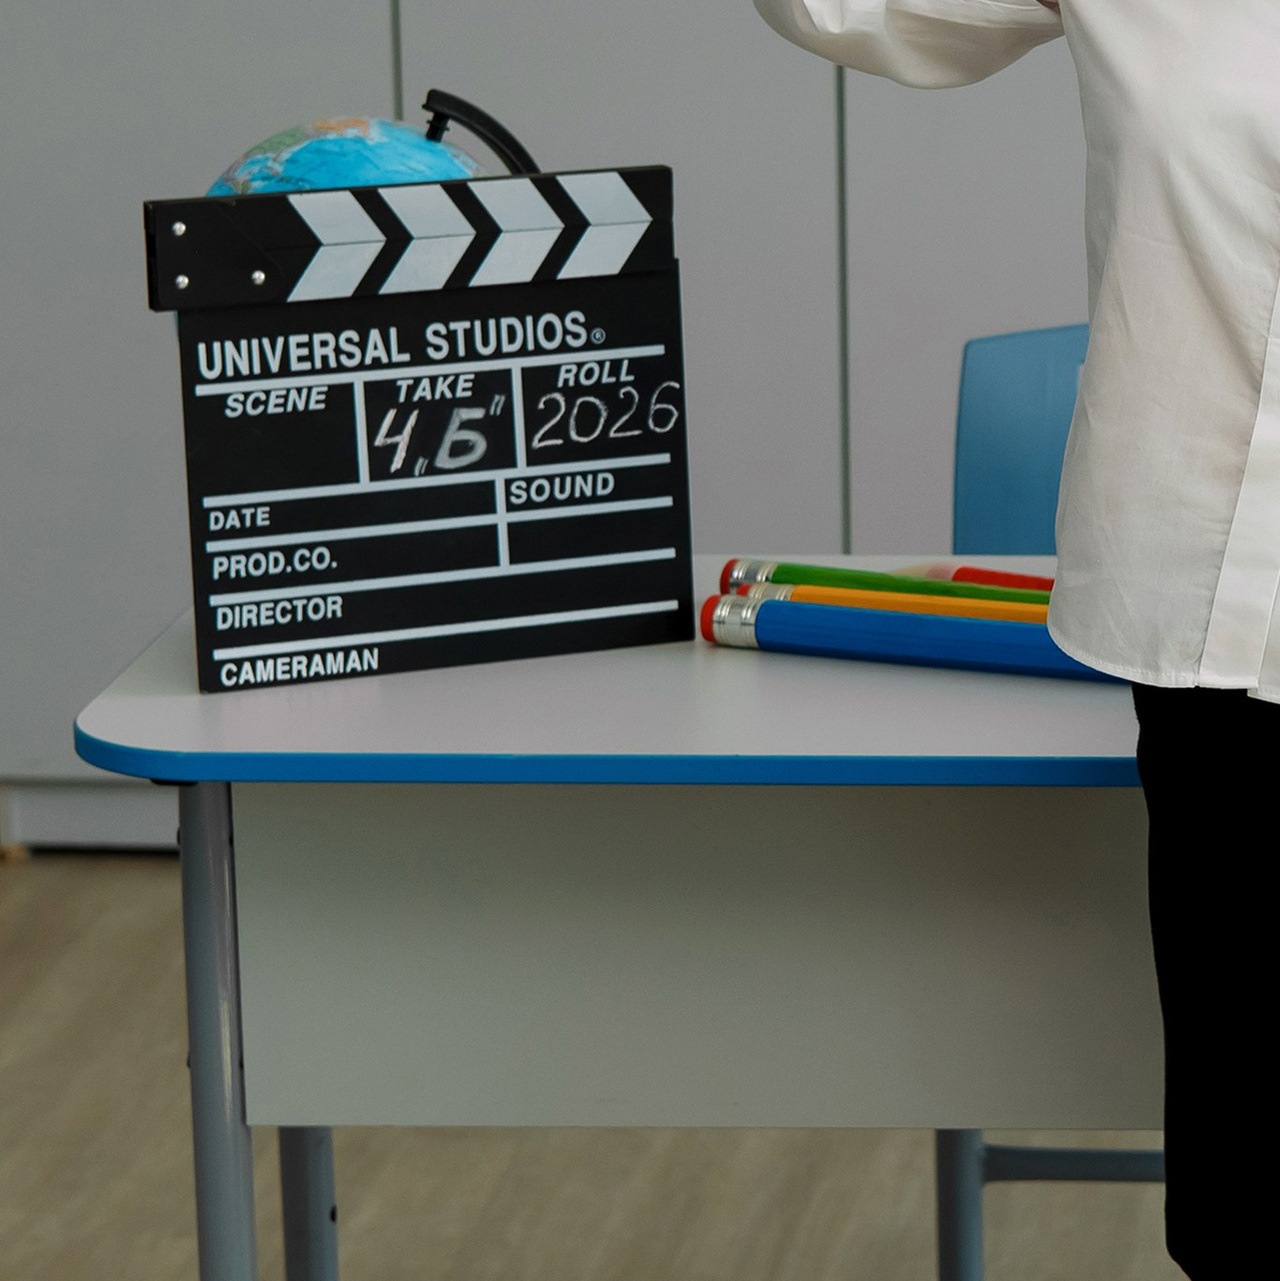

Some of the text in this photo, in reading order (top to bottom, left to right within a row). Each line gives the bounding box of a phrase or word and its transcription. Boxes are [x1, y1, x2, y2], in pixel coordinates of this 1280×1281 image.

[198, 326, 411, 380] UNIVERSAL
[396, 373, 475, 403] TAKE
[558, 359, 635, 388] ROLL
[225, 385, 328, 418] SCENE
[532, 381, 680, 449] 2026
[509, 472, 615, 504] SOUND
[209, 506, 271, 532] DATE
[212, 546, 338, 580] PROD.CO.
[216, 595, 343, 631] DIRECTOR
[220, 647, 379, 687] CAMERAMAN
